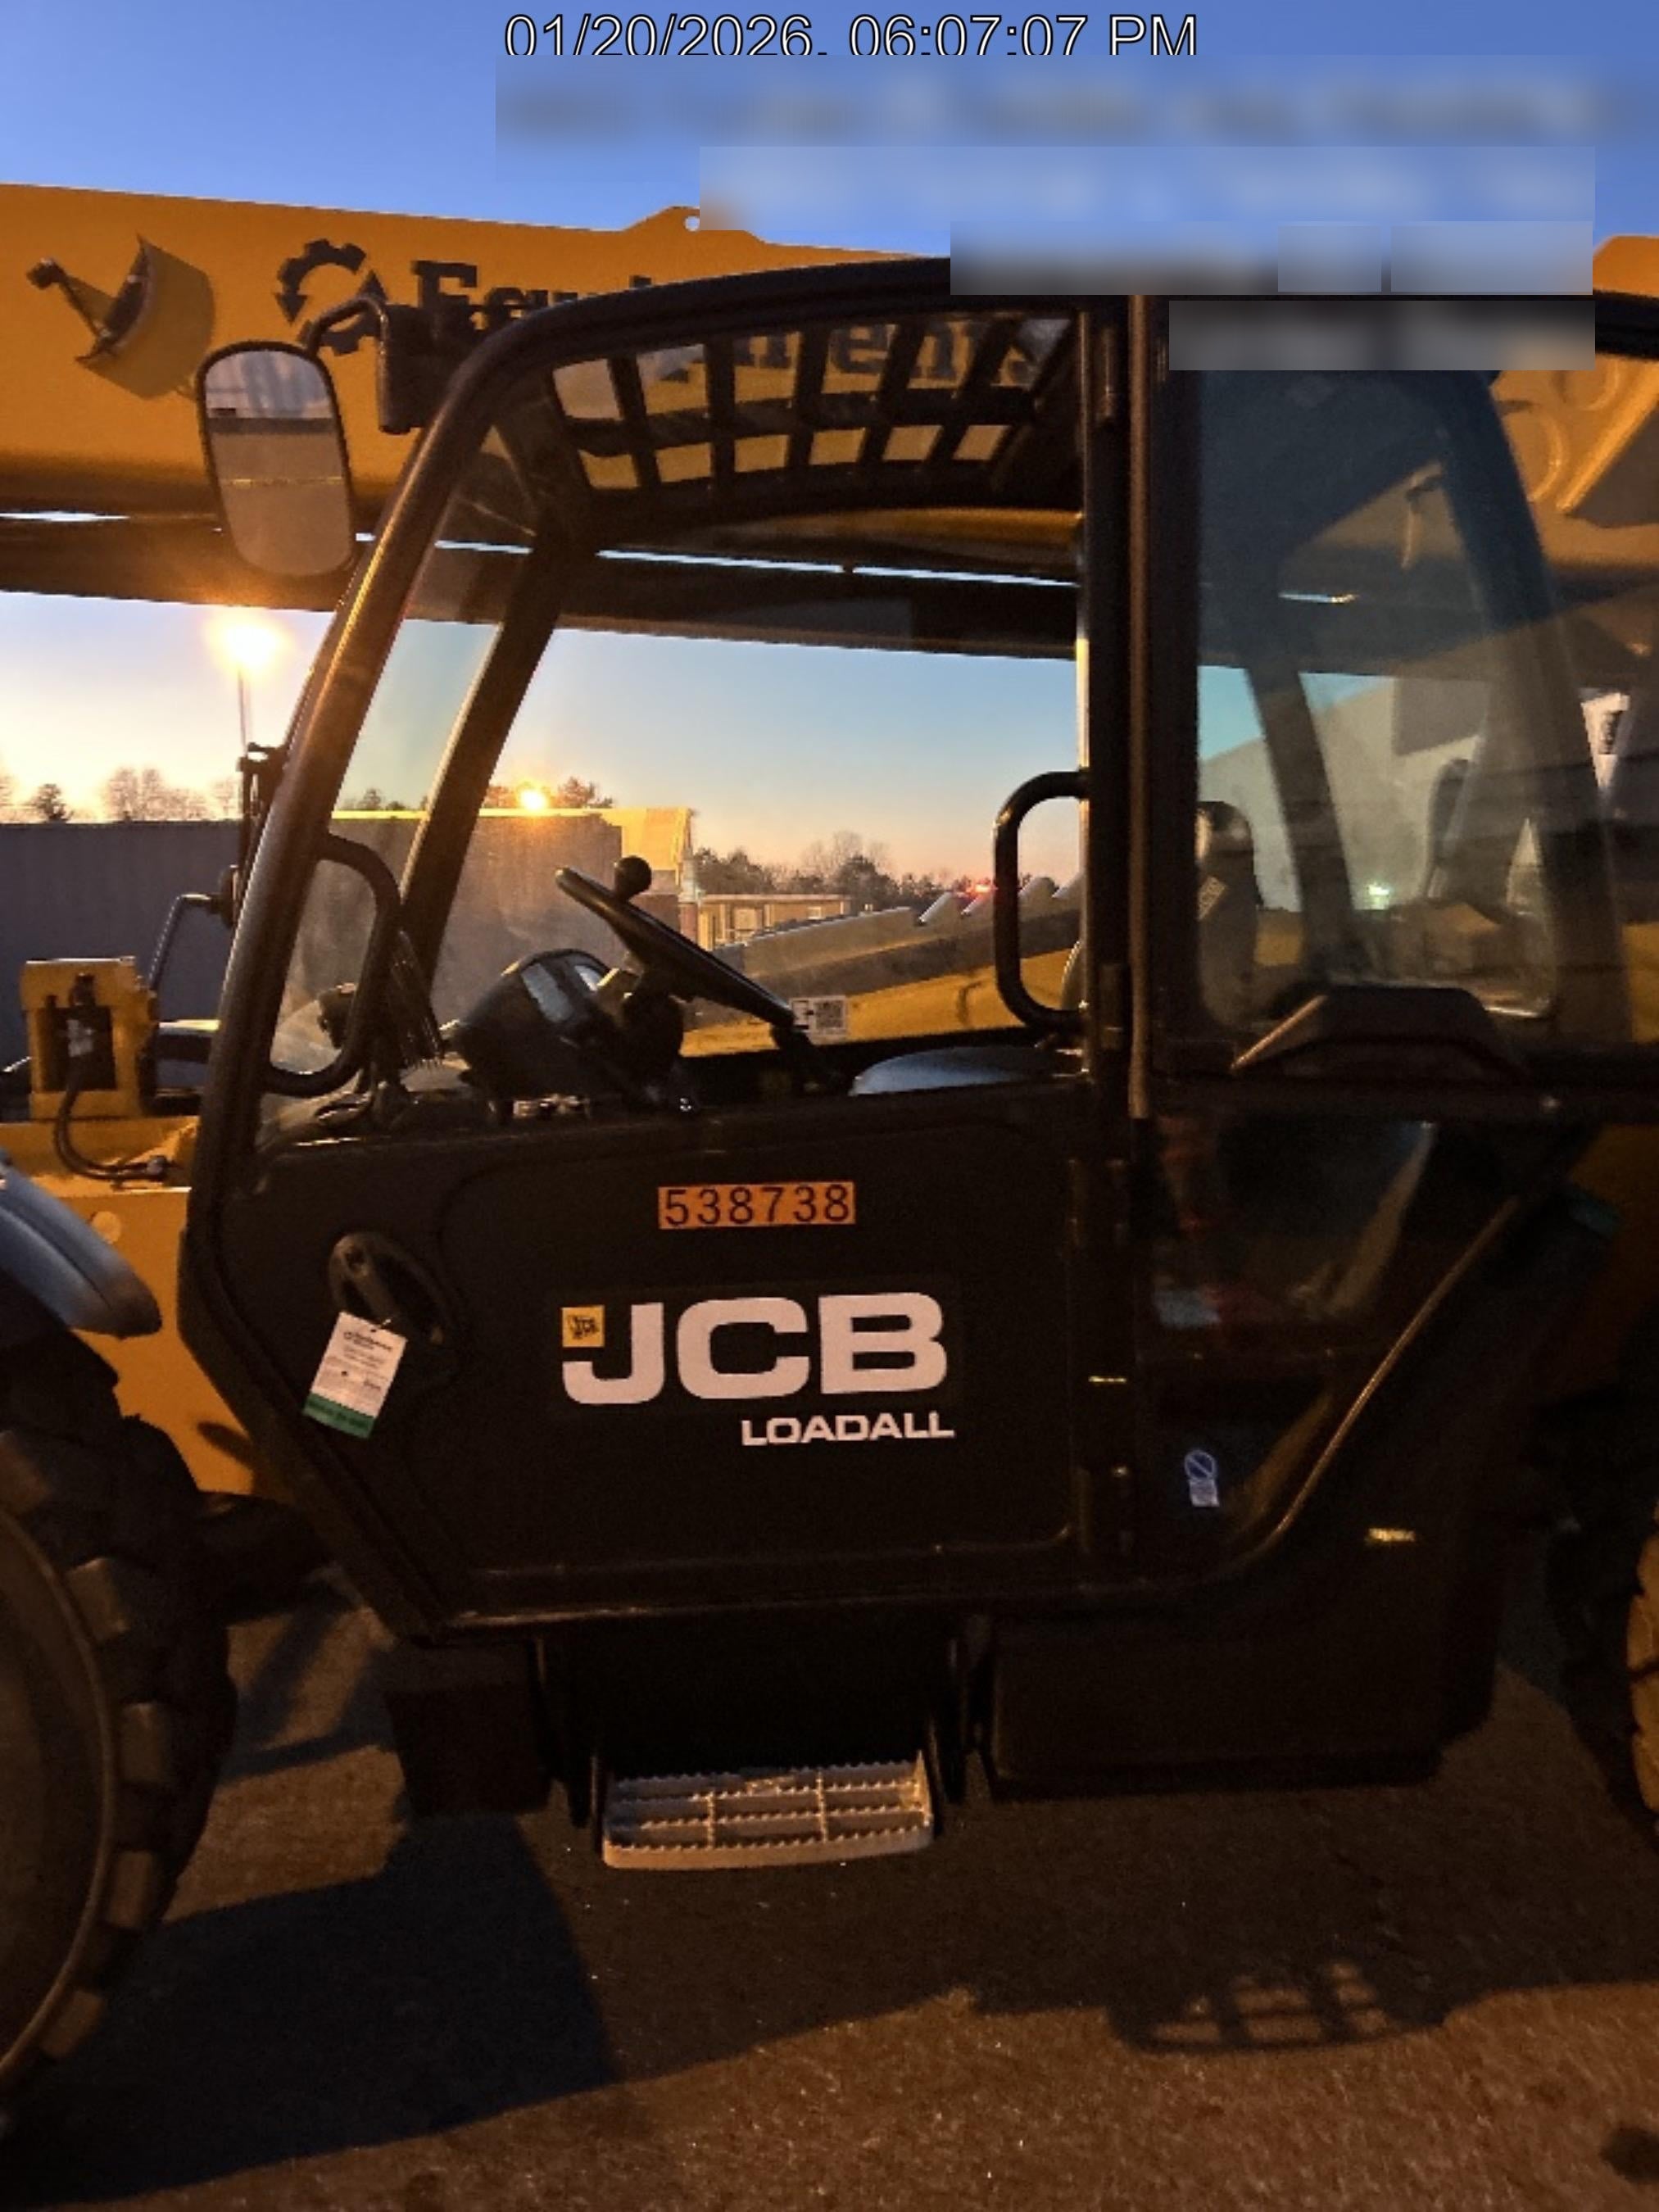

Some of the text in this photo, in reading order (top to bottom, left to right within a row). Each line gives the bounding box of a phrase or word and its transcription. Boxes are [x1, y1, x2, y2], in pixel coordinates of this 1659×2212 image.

[665, 1184, 850, 1226] 538738
[562, 1292, 948, 1405] JCB
[741, 1411, 955, 1446] LOADALL
